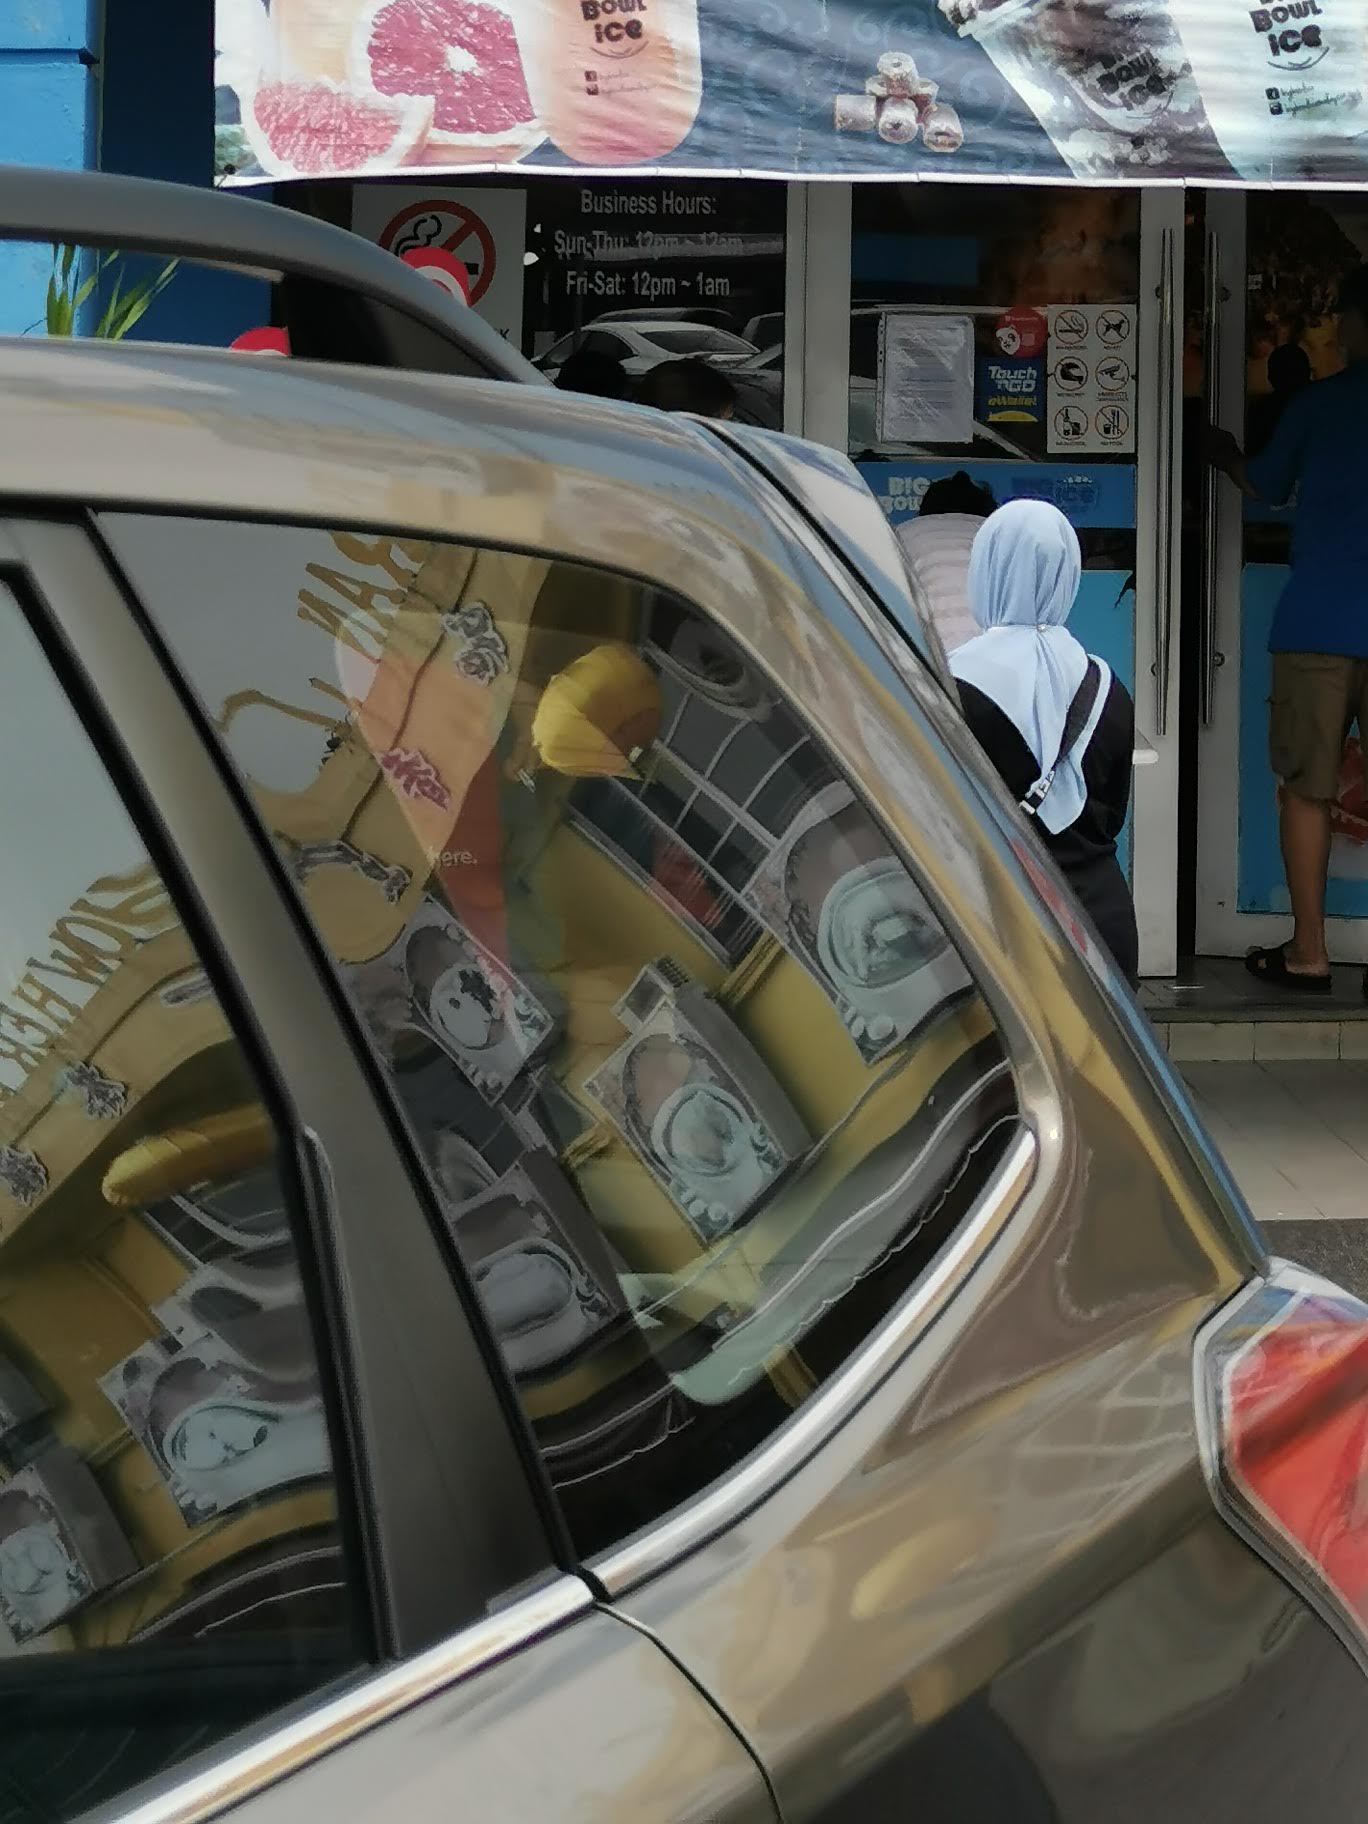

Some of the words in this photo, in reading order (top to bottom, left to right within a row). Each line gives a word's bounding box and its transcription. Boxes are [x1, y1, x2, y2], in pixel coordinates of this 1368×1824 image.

[580, 189, 657, 214] Business
[662, 190, 717, 214] Hours:
[566, 270, 626, 295] Fri-Sat:
[632, 271, 676, 302] 12pm
[696, 271, 730, 295] 1am
[987, 365, 1038, 380] Touch
